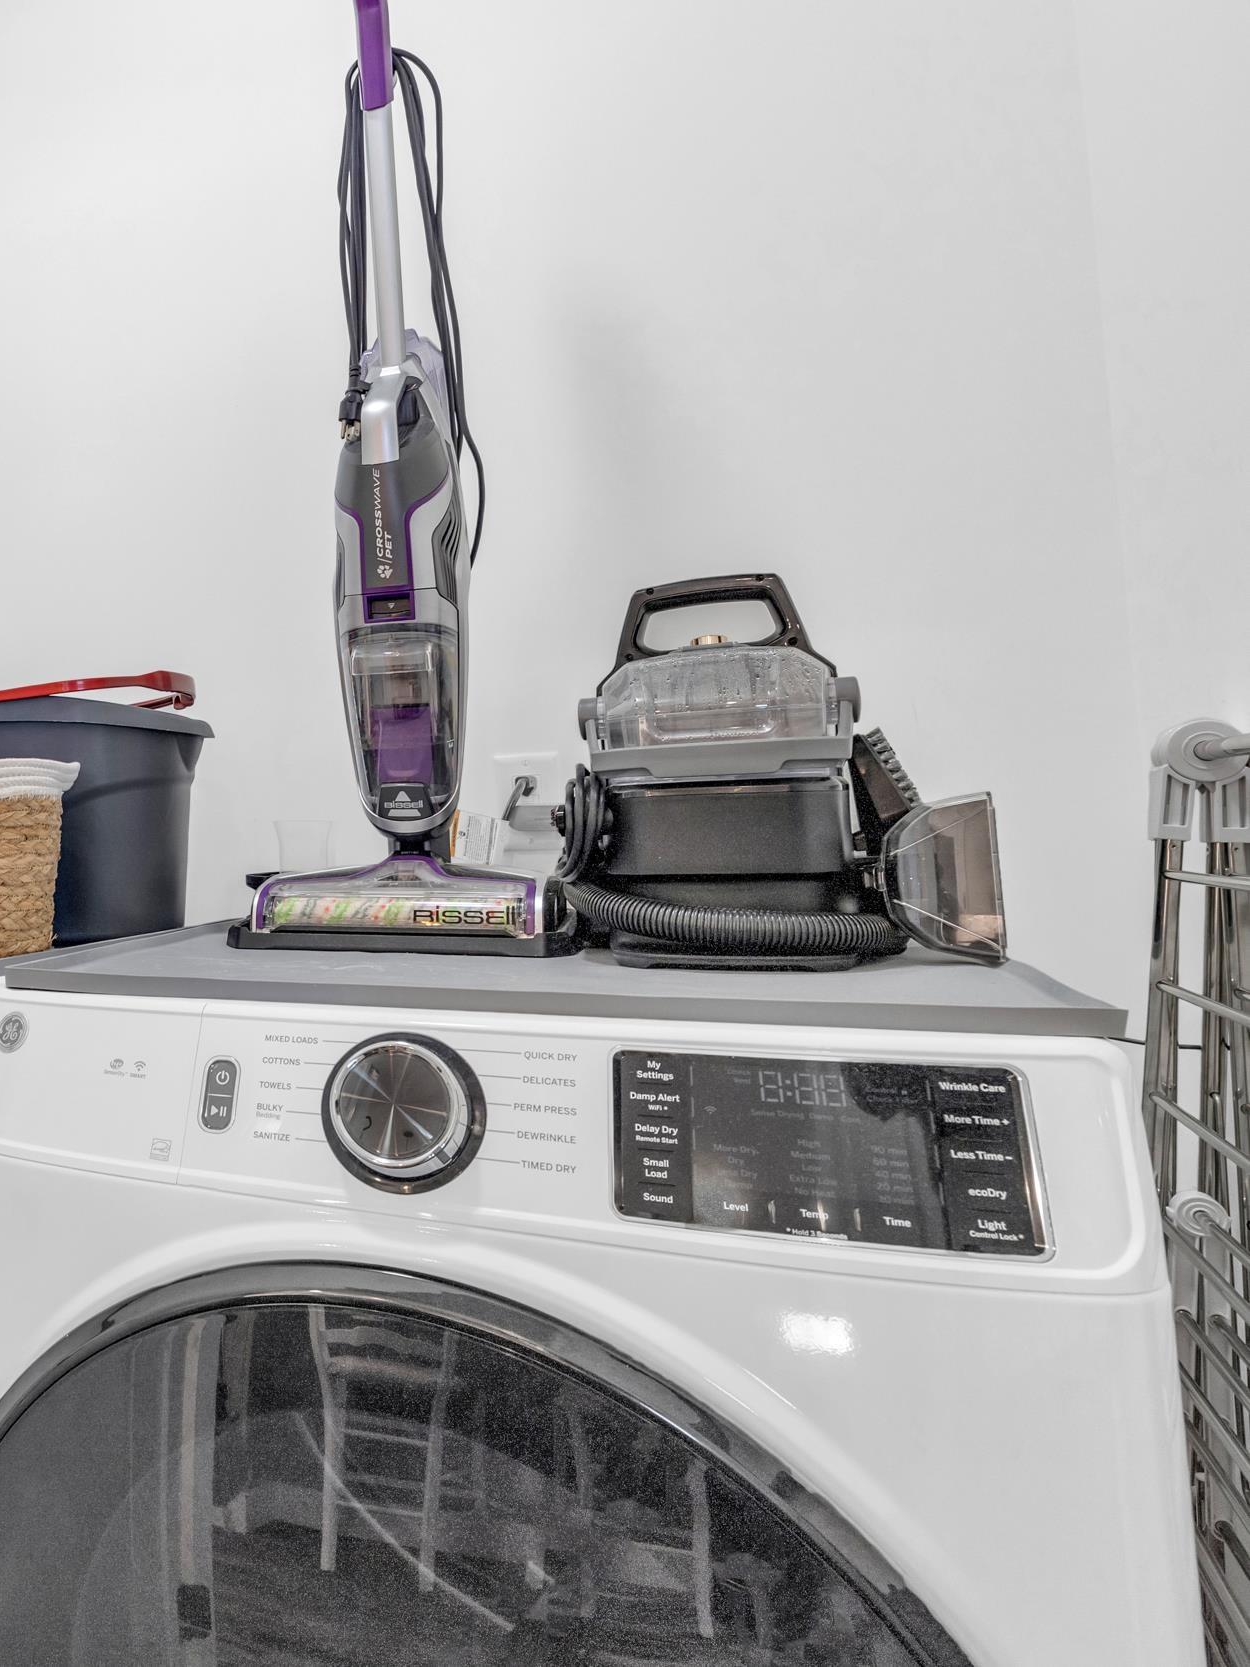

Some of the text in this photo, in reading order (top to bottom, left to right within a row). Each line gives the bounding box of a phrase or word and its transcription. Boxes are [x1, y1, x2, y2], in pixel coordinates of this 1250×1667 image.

[372, 468, 383, 557] CROSSWAVE
[384, 531, 393, 559] PET
[264, 1034, 319, 1044] MIXED LOADS
[262, 1056, 301, 1066] COTTONS
[524, 1050, 578, 1062] QUICK DRY
[647, 1061, 661, 1070] My
[636, 1070, 674, 1081] Settings
[259, 1081, 292, 1090] TOWELS
[522, 1076, 576, 1088] DELICATES
[938, 1081, 1006, 1093] Wrinkle Care
[630, 1091, 680, 1102] Damp Alert
[256, 1102, 284, 1111] BULKY
[513, 1102, 577, 1117] PERM PRESS
[944, 1114, 972, 1125] More
[972, 1115, 1000, 1126] Time
[635, 1123, 678, 1136] Delay Dry
[253, 1131, 291, 1142] SANITIZE
[517, 1131, 577, 1144] DEWRINKLE
[635, 1134, 661, 1143] Remote
[950, 1149, 1004, 1161] Less Time
[521, 1160, 577, 1174] TIMED DRY
[643, 1157, 669, 1168] Small
[645, 1169, 668, 1179] Load
[643, 1192, 674, 1204] Sound
[968, 1188, 1007, 1200] ecoDry
[723, 1201, 749, 1212] Level
[799, 1208, 829, 1220] Temp
[882, 1216, 912, 1228] Time
[977, 1219, 1007, 1231] Light
[791, 1228, 810, 1236] Hold
[969, 1229, 1019, 1241] Control Lock
